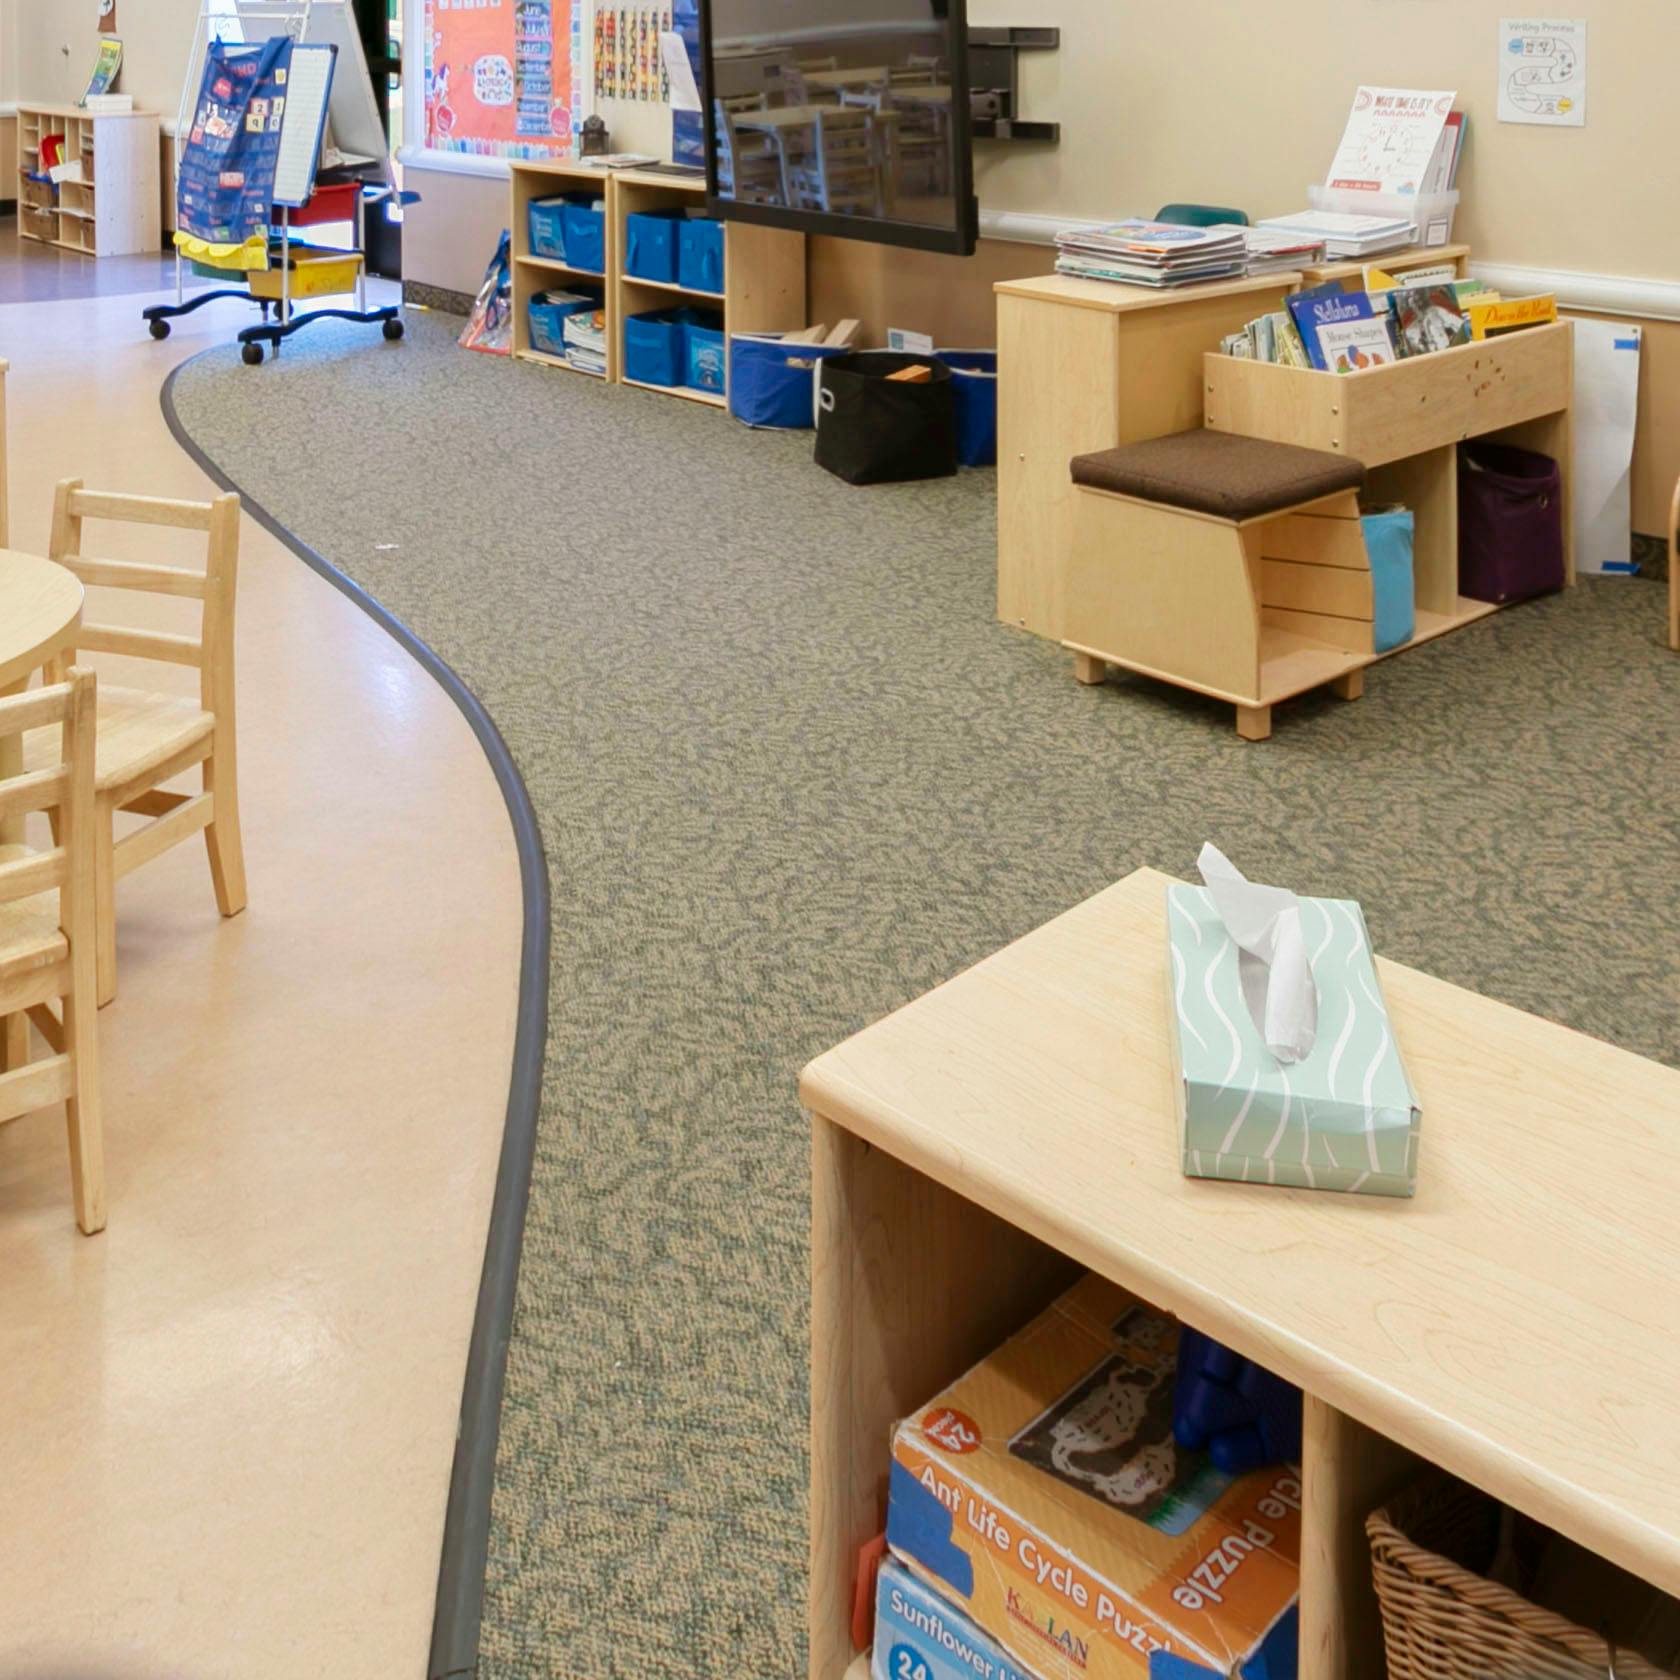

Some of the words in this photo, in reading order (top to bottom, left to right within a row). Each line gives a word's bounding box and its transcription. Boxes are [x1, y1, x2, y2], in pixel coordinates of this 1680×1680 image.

[1312, 297, 1360, 323] Stellaluna
[940, 1422, 976, 1452] 24
[1257, 1461, 1303, 1520] cle
[920, 1465, 963, 1514] Ant
[968, 1498, 1011, 1551] Life
[1019, 1538, 1089, 1608] Cycle
[1172, 1519, 1274, 1611] Puzzle
[890, 1589, 994, 1679] Sunflower
[897, 1651, 927, 1680] 24
